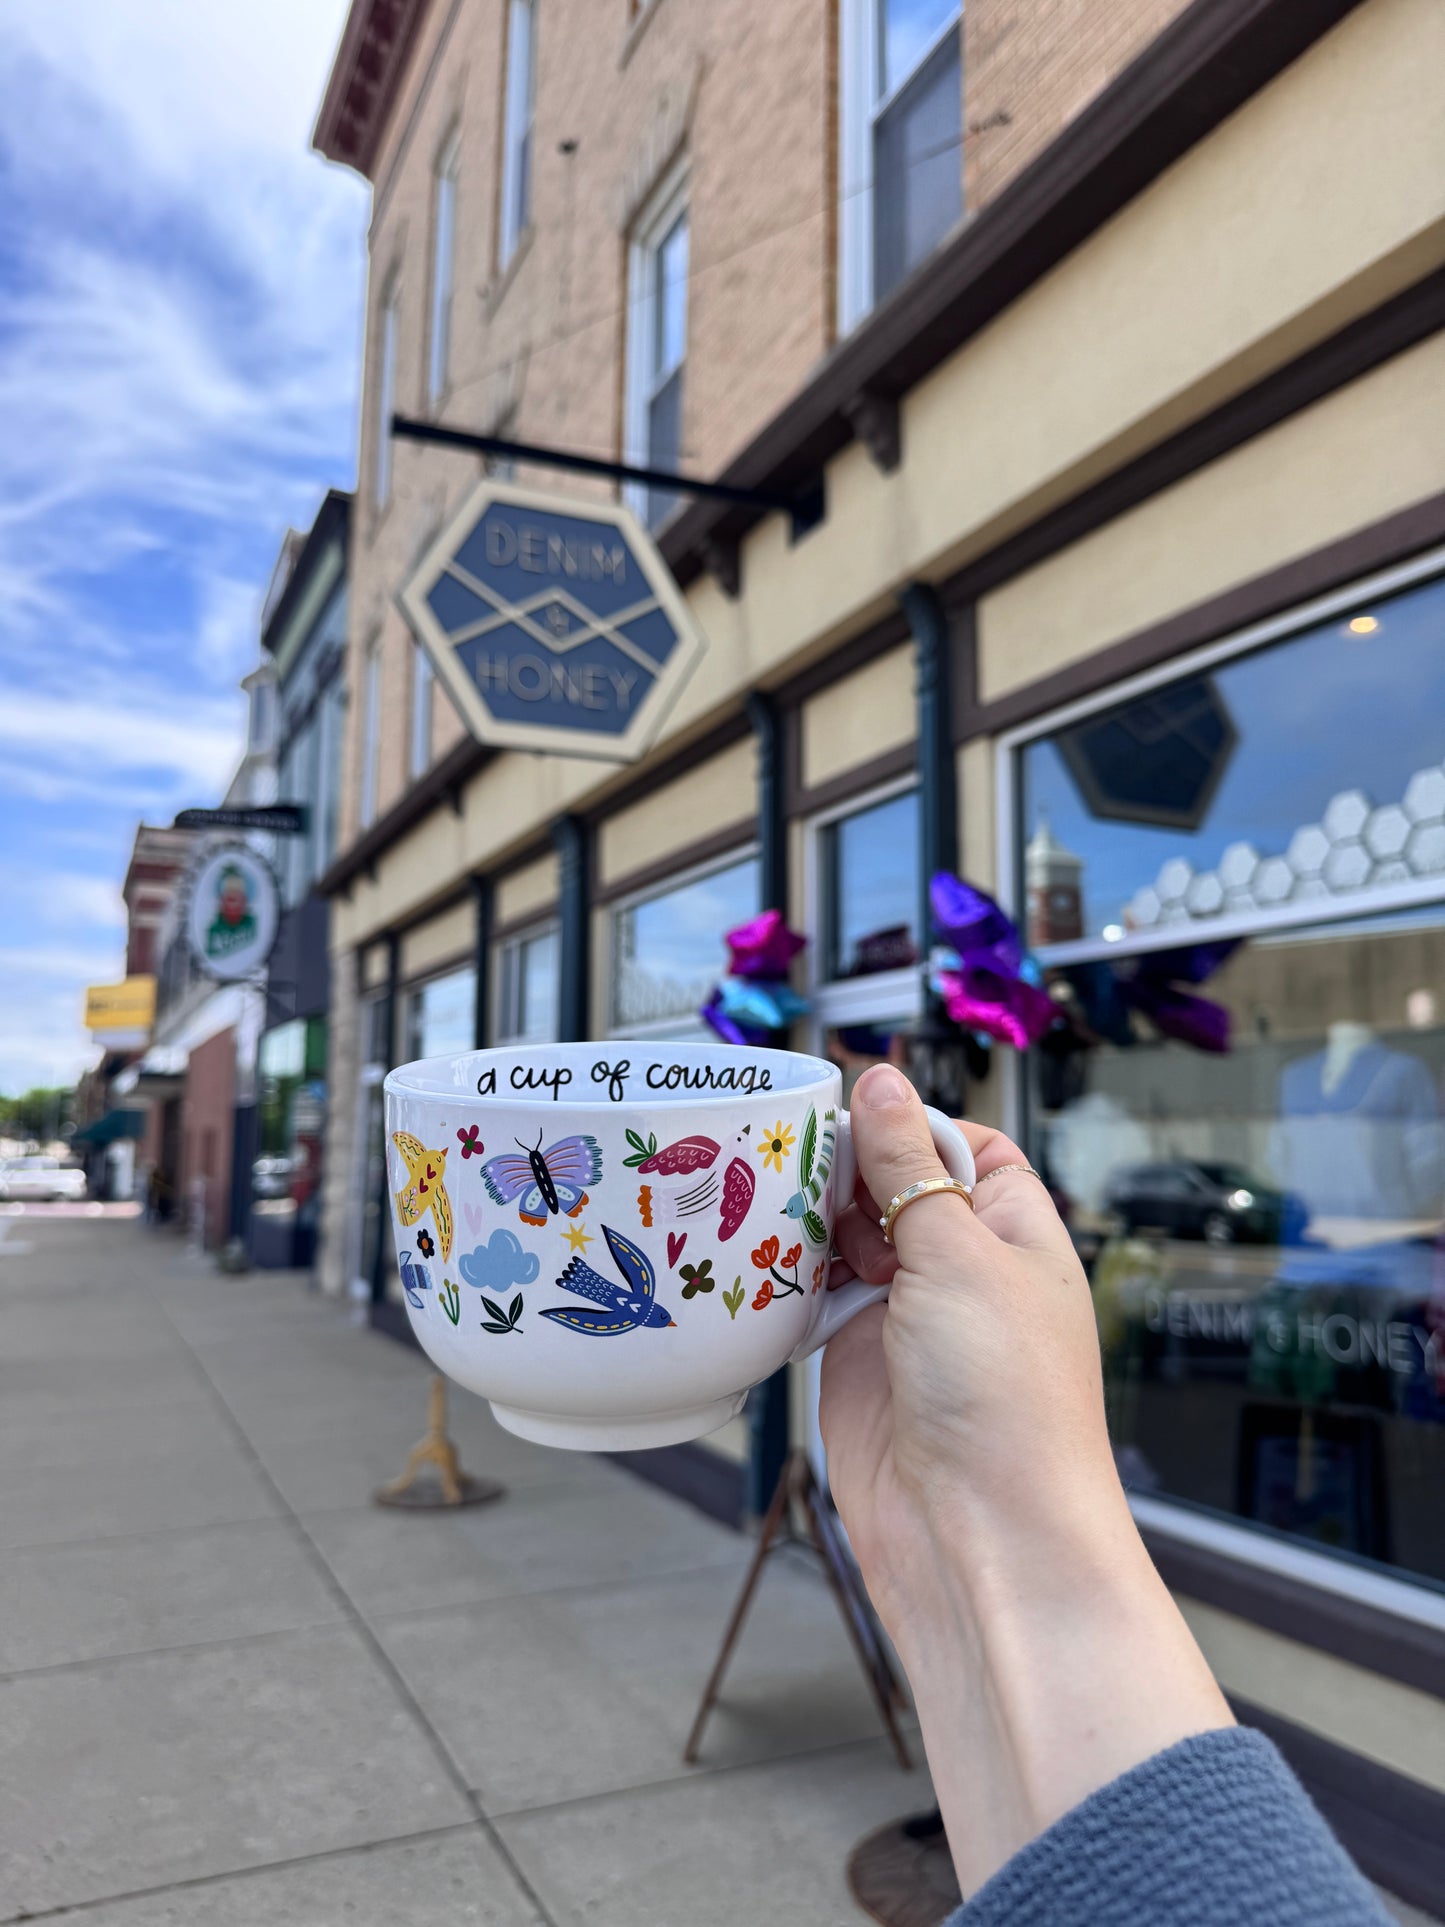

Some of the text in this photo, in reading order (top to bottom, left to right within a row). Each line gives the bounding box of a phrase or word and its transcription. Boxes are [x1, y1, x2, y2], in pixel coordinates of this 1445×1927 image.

[484, 519, 627, 585] DENIM
[475, 652, 638, 712] HONEY
[477, 1059, 773, 1102] a cup of courage
[1144, 1287, 1251, 1347] DENIM
[1297, 1313, 1442, 1376] HONEY
